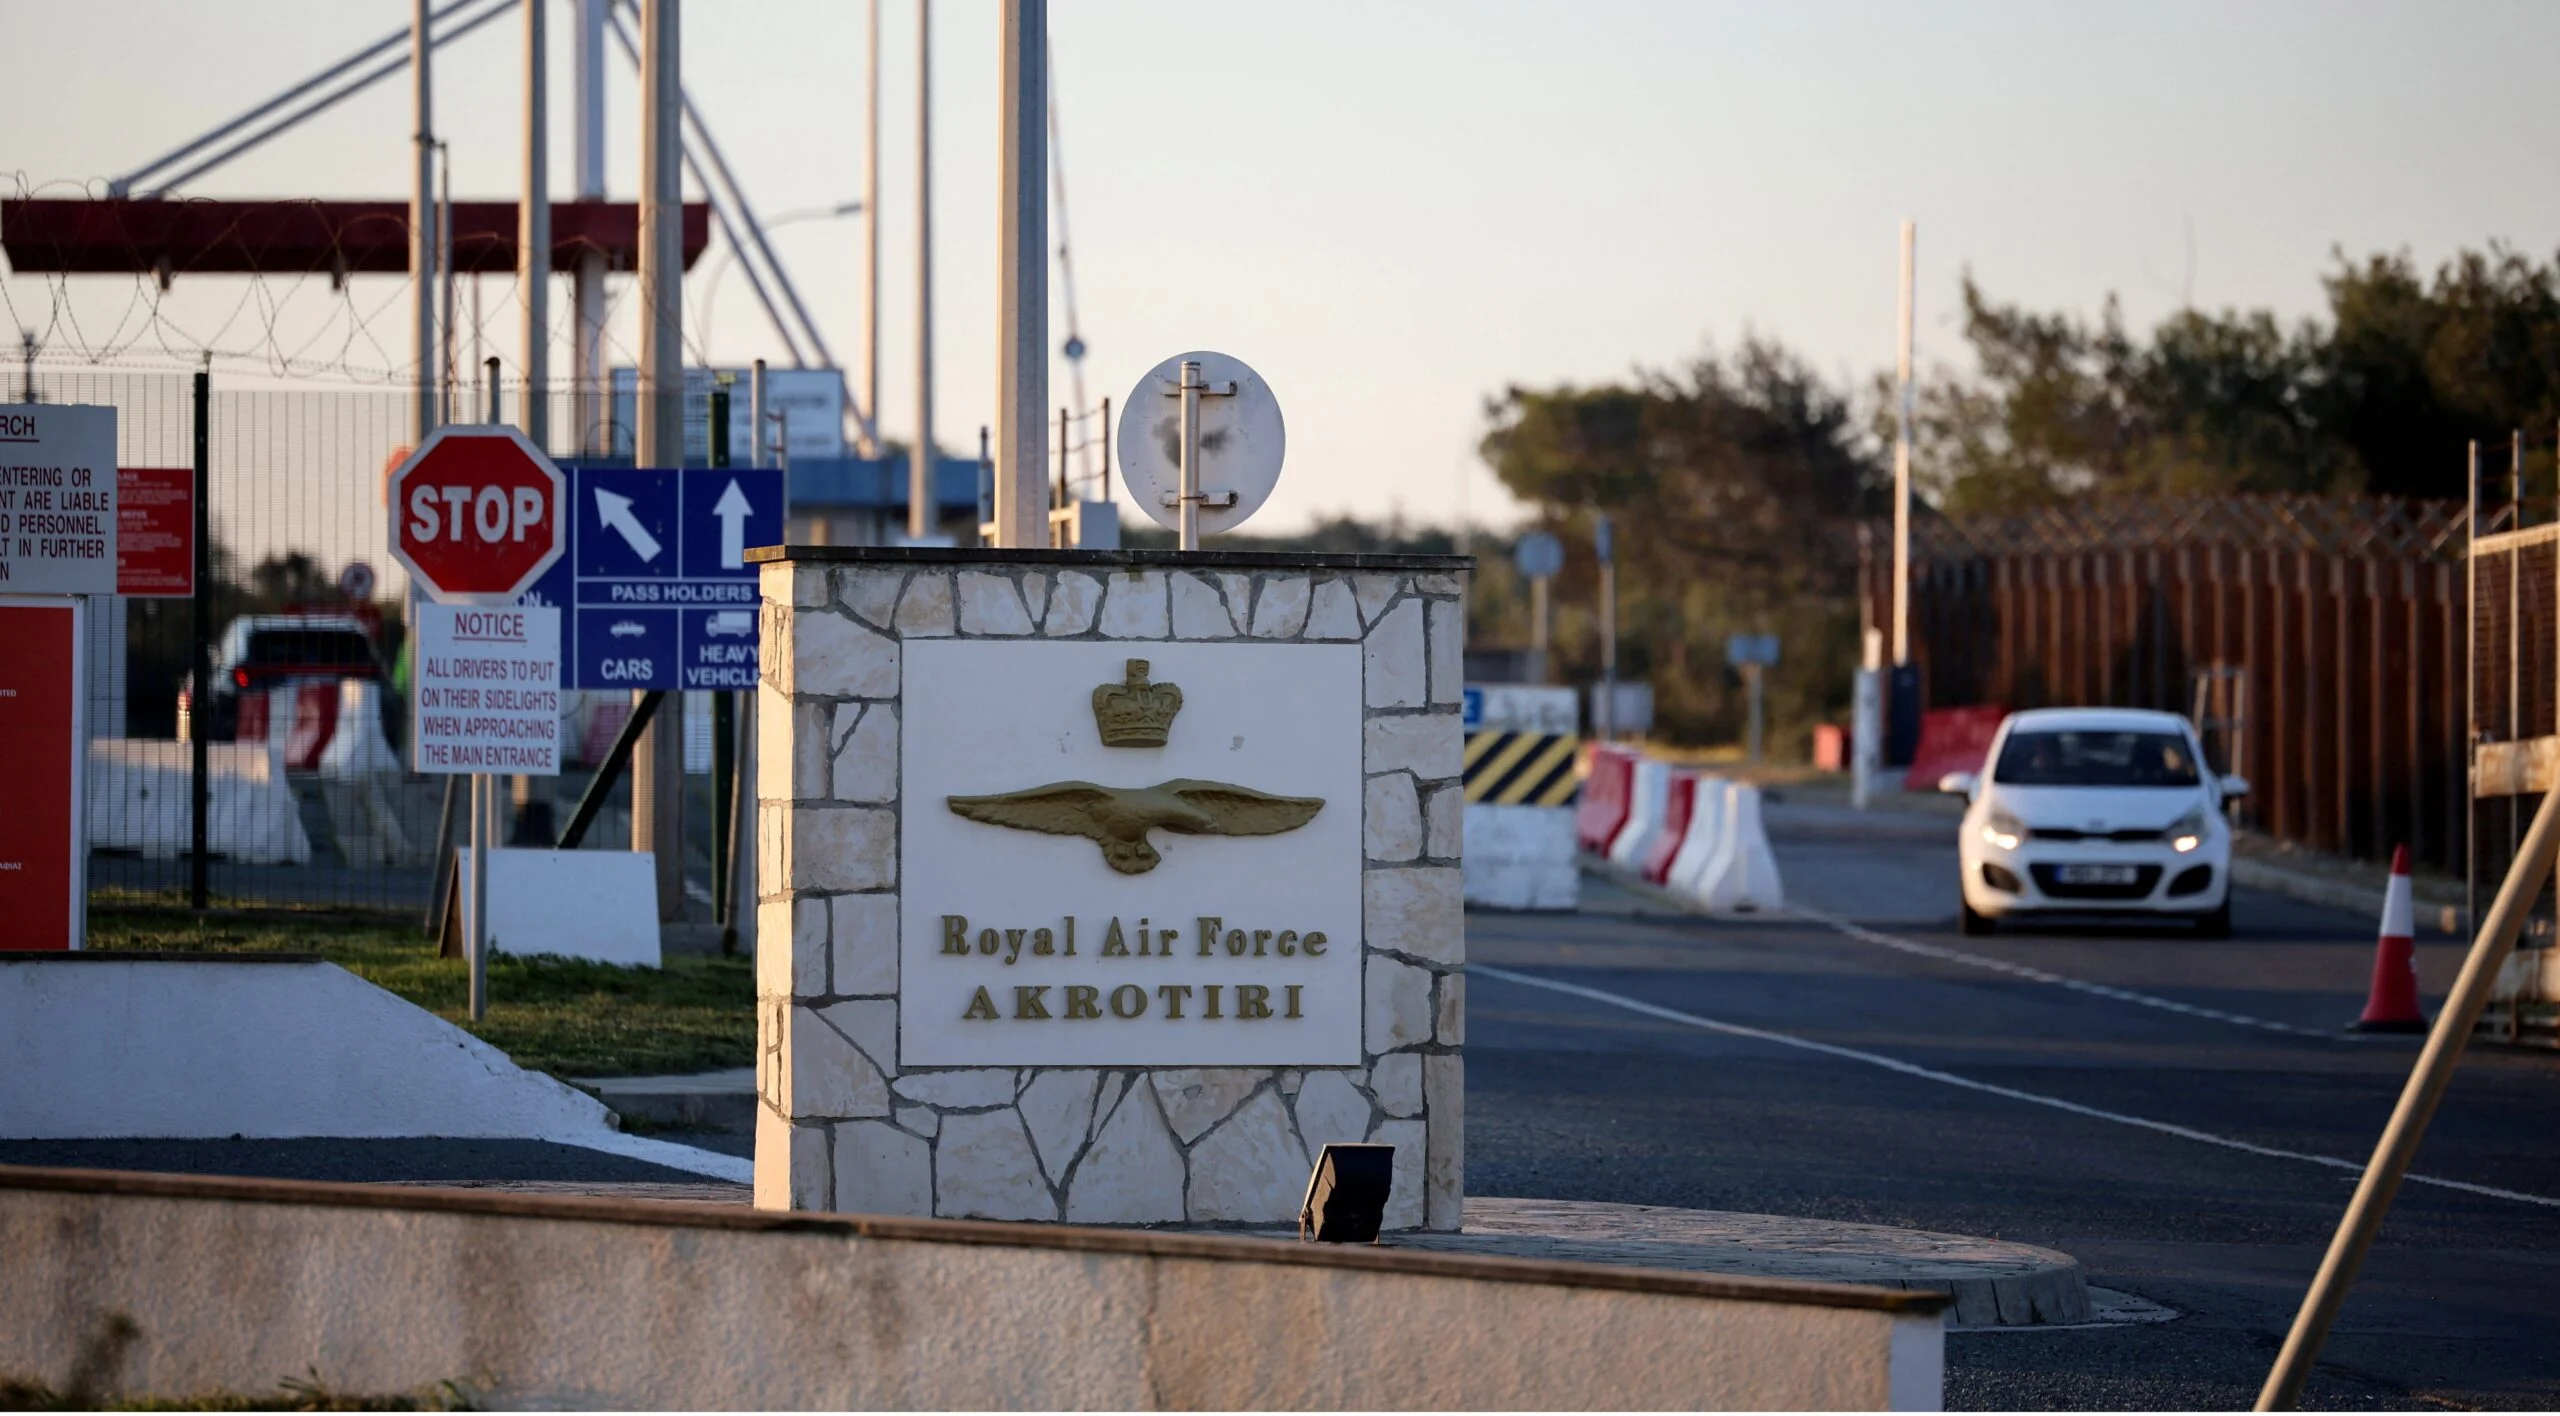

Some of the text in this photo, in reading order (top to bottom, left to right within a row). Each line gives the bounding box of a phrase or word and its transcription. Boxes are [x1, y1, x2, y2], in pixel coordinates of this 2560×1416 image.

[0, 415, 35, 436] RCH
[0, 466, 91, 488] NTERING OR
[24, 491, 52, 510] ARE
[61, 492, 109, 512] LIABLE
[1, 514, 10, 533] D
[19, 514, 106, 535] PERSONNEL.
[409, 484, 544, 543] STOP
[0, 537, 10, 557] T
[19, 538, 32, 557] IN
[41, 539, 105, 558] FURTHER
[0, 562, 9, 581] N
[611, 584, 753, 601] PASS HOLDERS
[455, 612, 524, 636] NOTICE
[700, 644, 759, 663] HEAVY
[426, 657, 554, 681] ALL DRIVERS TO PUT
[601, 658, 654, 681] CARS
[421, 687, 557, 711] ON THEIR SIDELIGHTS
[424, 716, 555, 739] WHEN APPROACHING
[424, 744, 552, 768] THE MAIN ENTRANCE
[940, 915, 1328, 964] Royal Air Force
[962, 984, 1304, 1020] AKROTIRI
